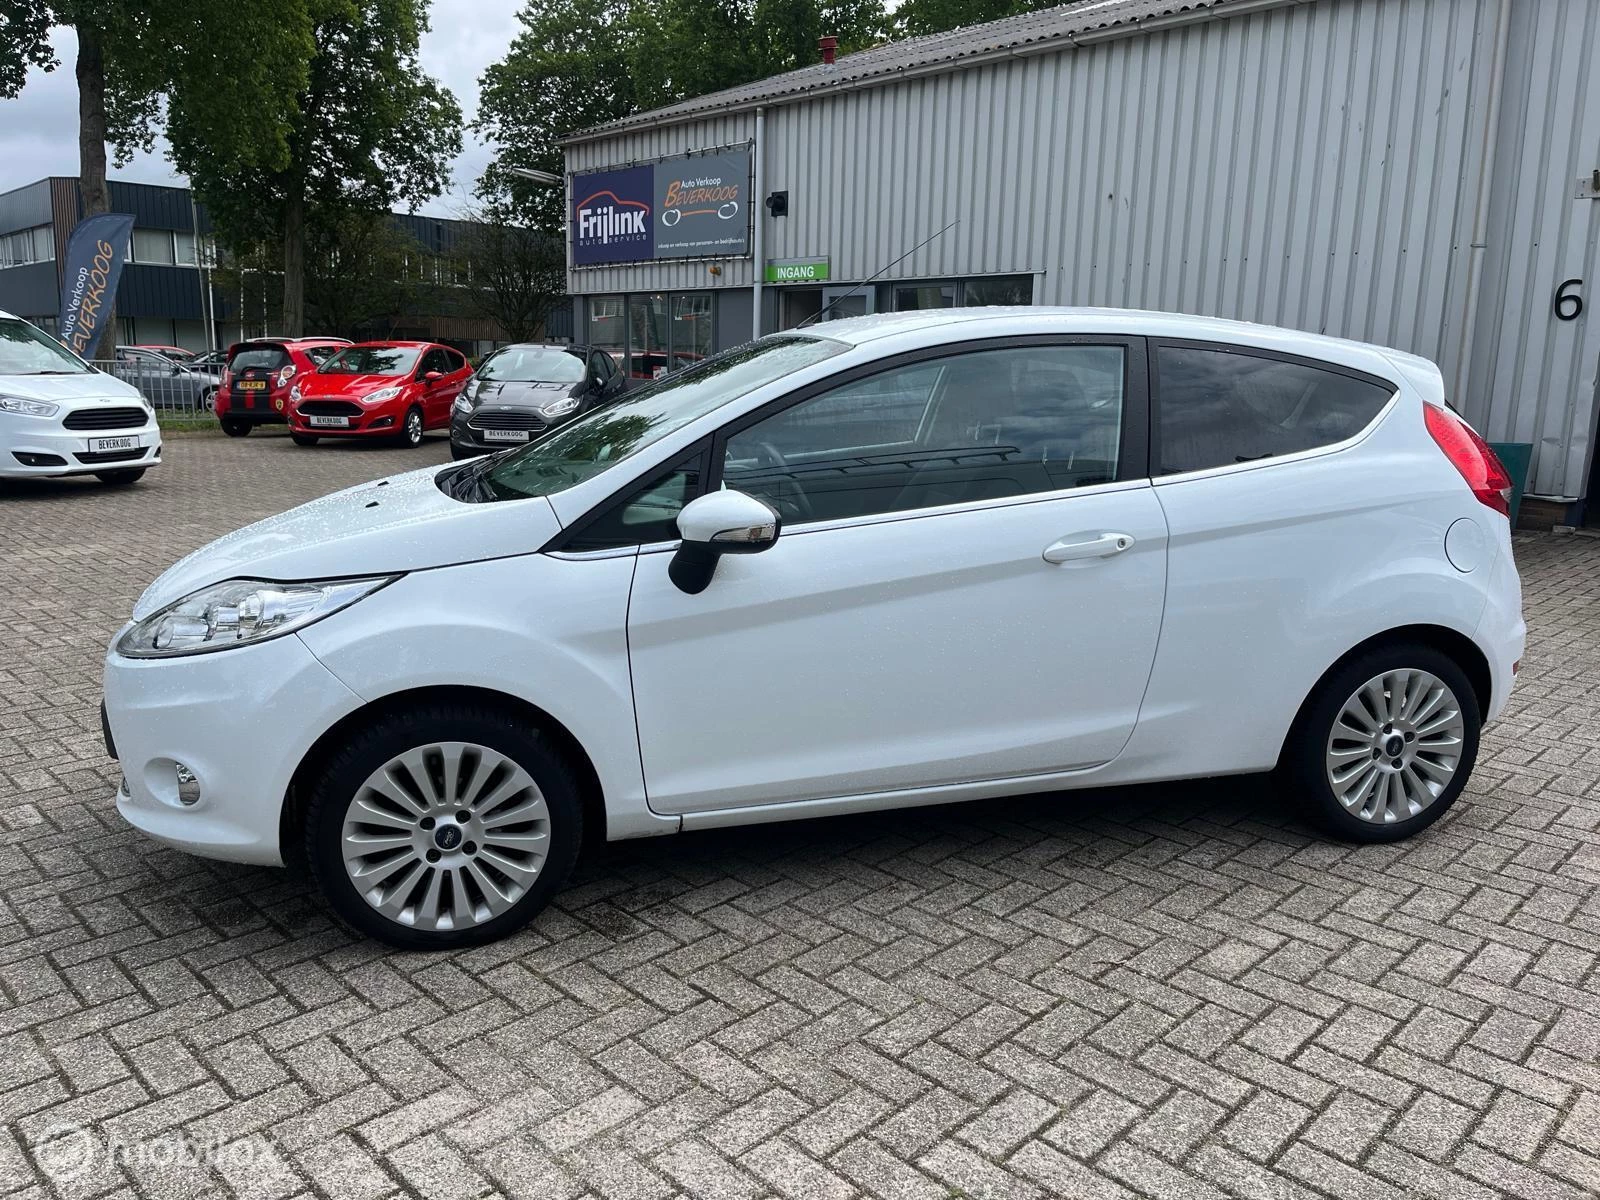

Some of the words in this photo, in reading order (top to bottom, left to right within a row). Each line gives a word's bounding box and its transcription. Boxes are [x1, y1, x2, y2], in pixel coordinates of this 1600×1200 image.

[681, 180, 696, 189] Auto
[696, 176, 721, 187] Verkoop
[777, 266, 814, 279] INGANG
[67, 267, 88, 313] Verkoop
[1555, 278, 1583, 321] 6
[61, 314, 77, 341] Auto
[98, 438, 132, 450] BEVERKOOG
